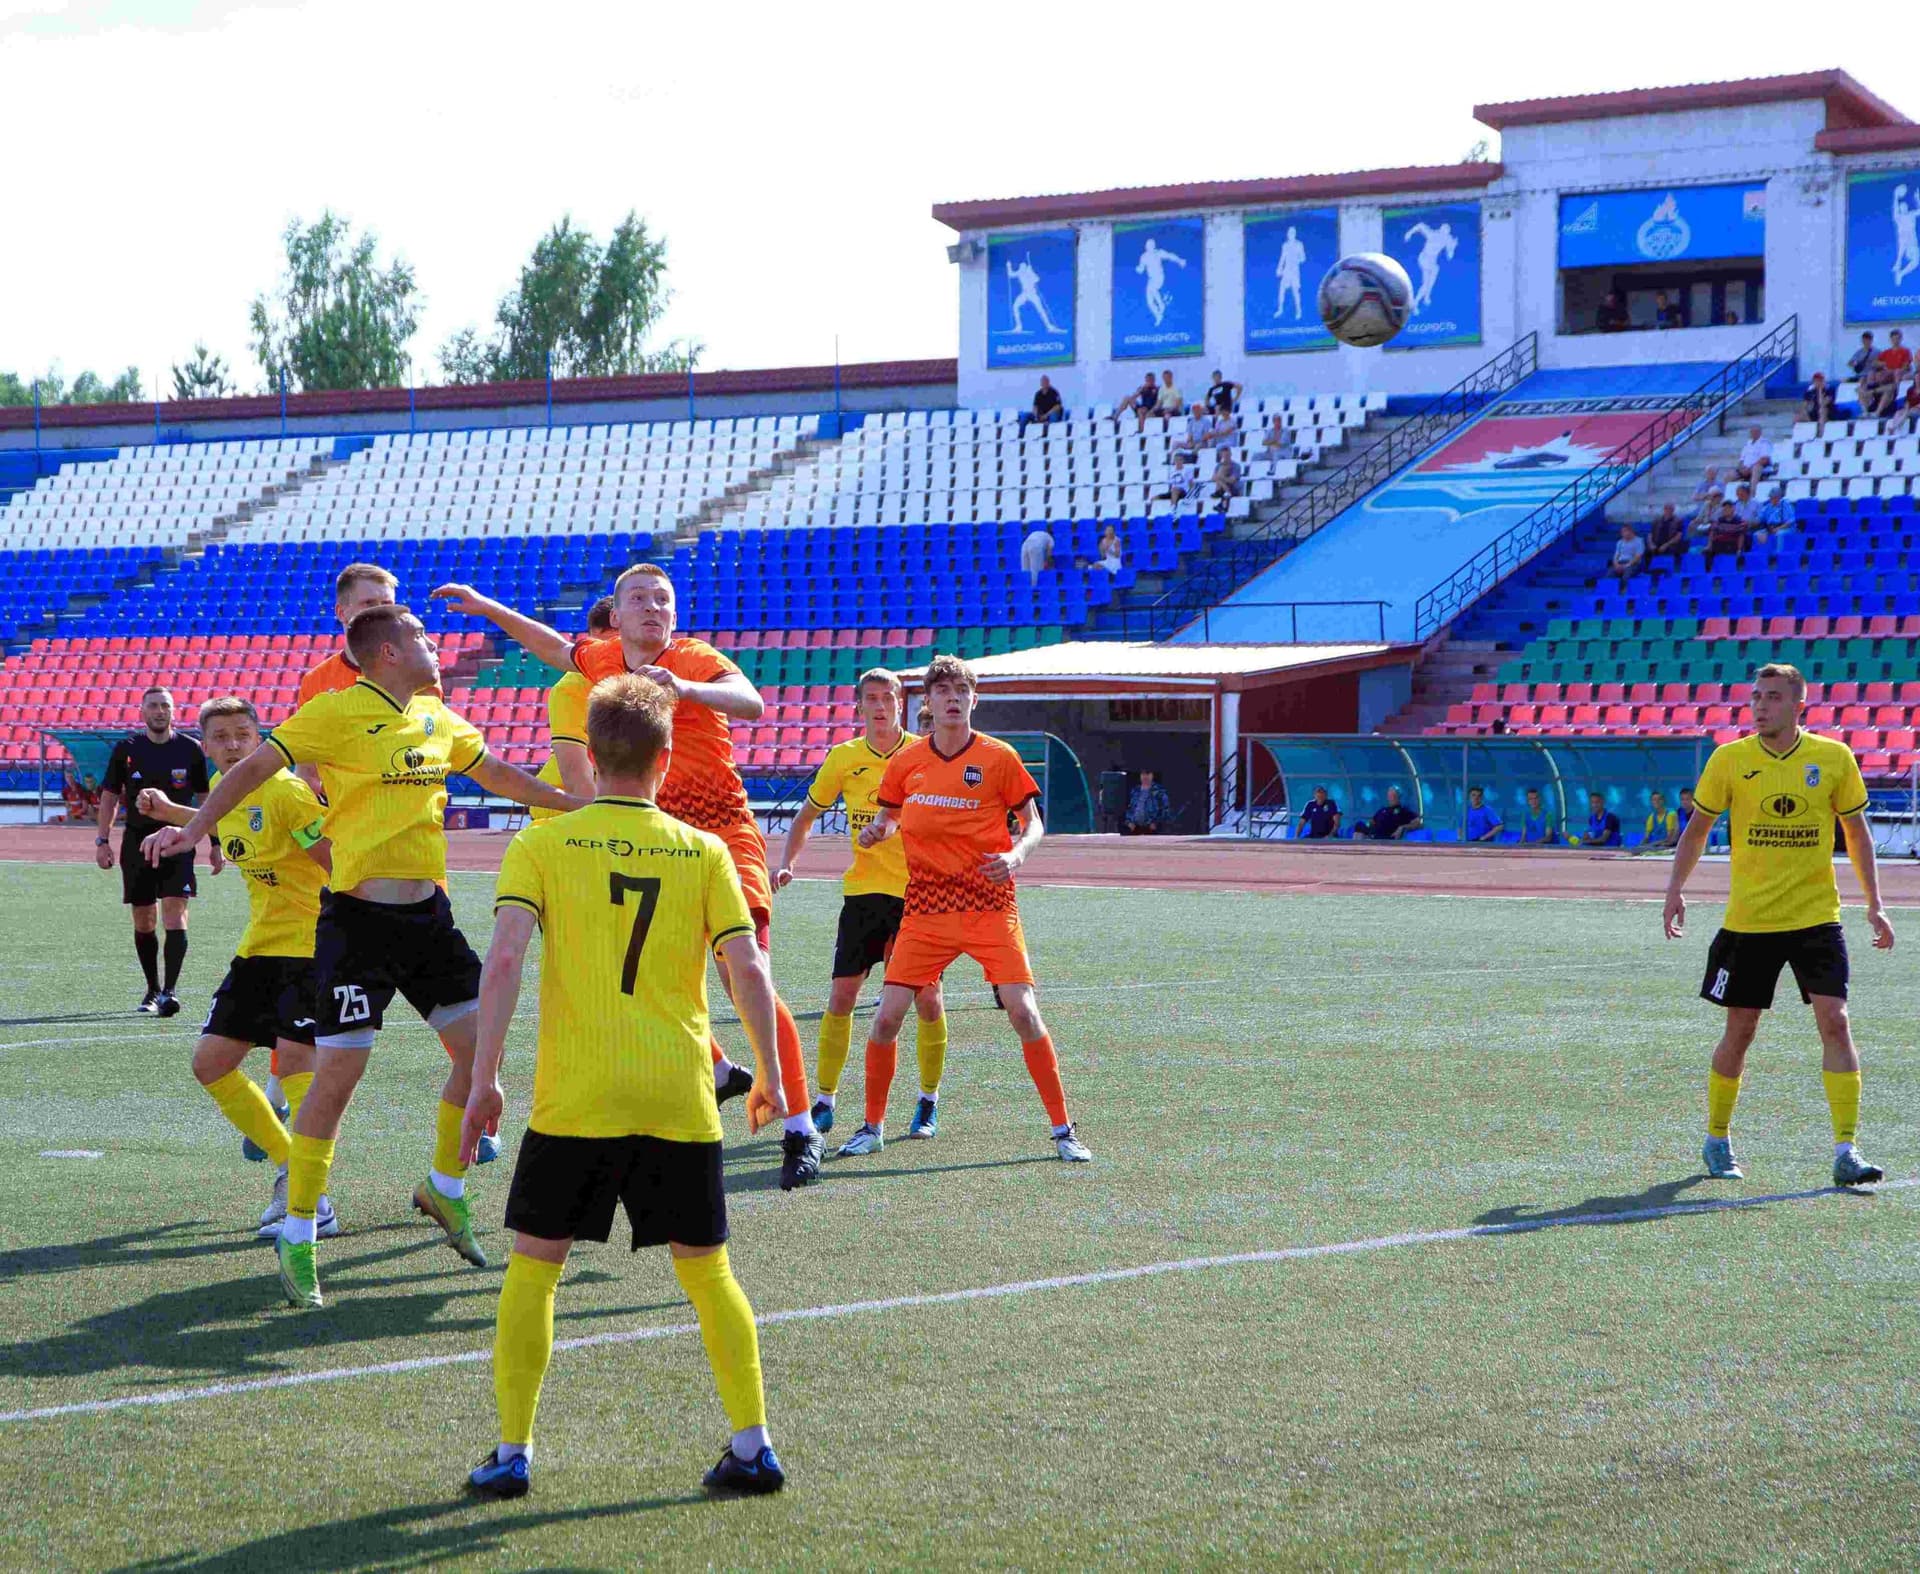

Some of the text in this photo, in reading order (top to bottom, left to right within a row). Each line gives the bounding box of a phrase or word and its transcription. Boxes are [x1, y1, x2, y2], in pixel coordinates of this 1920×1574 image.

[565, 838, 700, 858] АСР ГРУПП
[1747, 838, 1819, 848] ФЕРРОСПЛАВЫ
[609, 872, 661, 996] 7
[1710, 967, 1729, 1000] 18
[333, 984, 371, 1024] 25
